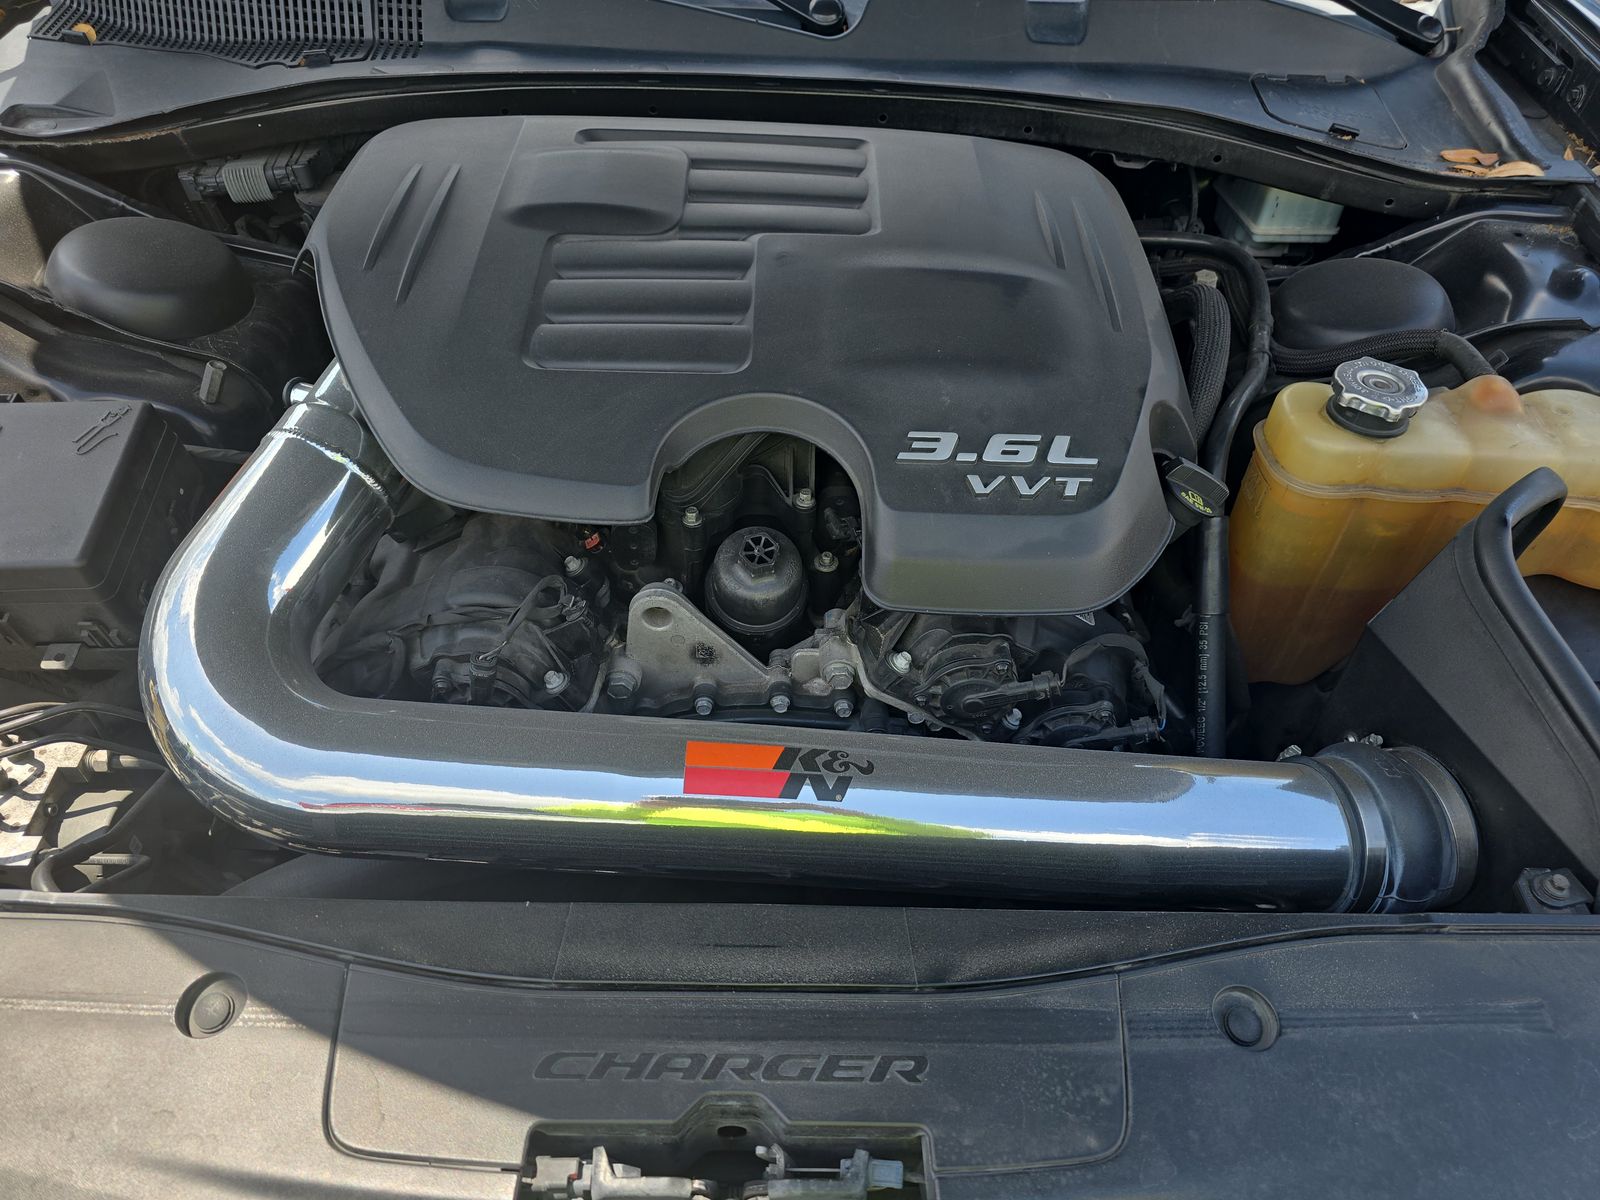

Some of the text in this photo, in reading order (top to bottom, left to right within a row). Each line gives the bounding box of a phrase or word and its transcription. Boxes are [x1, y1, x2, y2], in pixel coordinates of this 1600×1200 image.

[896, 431, 1099, 468] 3.6L
[966, 474, 1094, 500] VVT
[1199, 621, 1209, 635] PSI
[1198, 639, 1208, 650] 35
[773, 746, 875, 803] K&N
[533, 1051, 930, 1083] CHARGER
